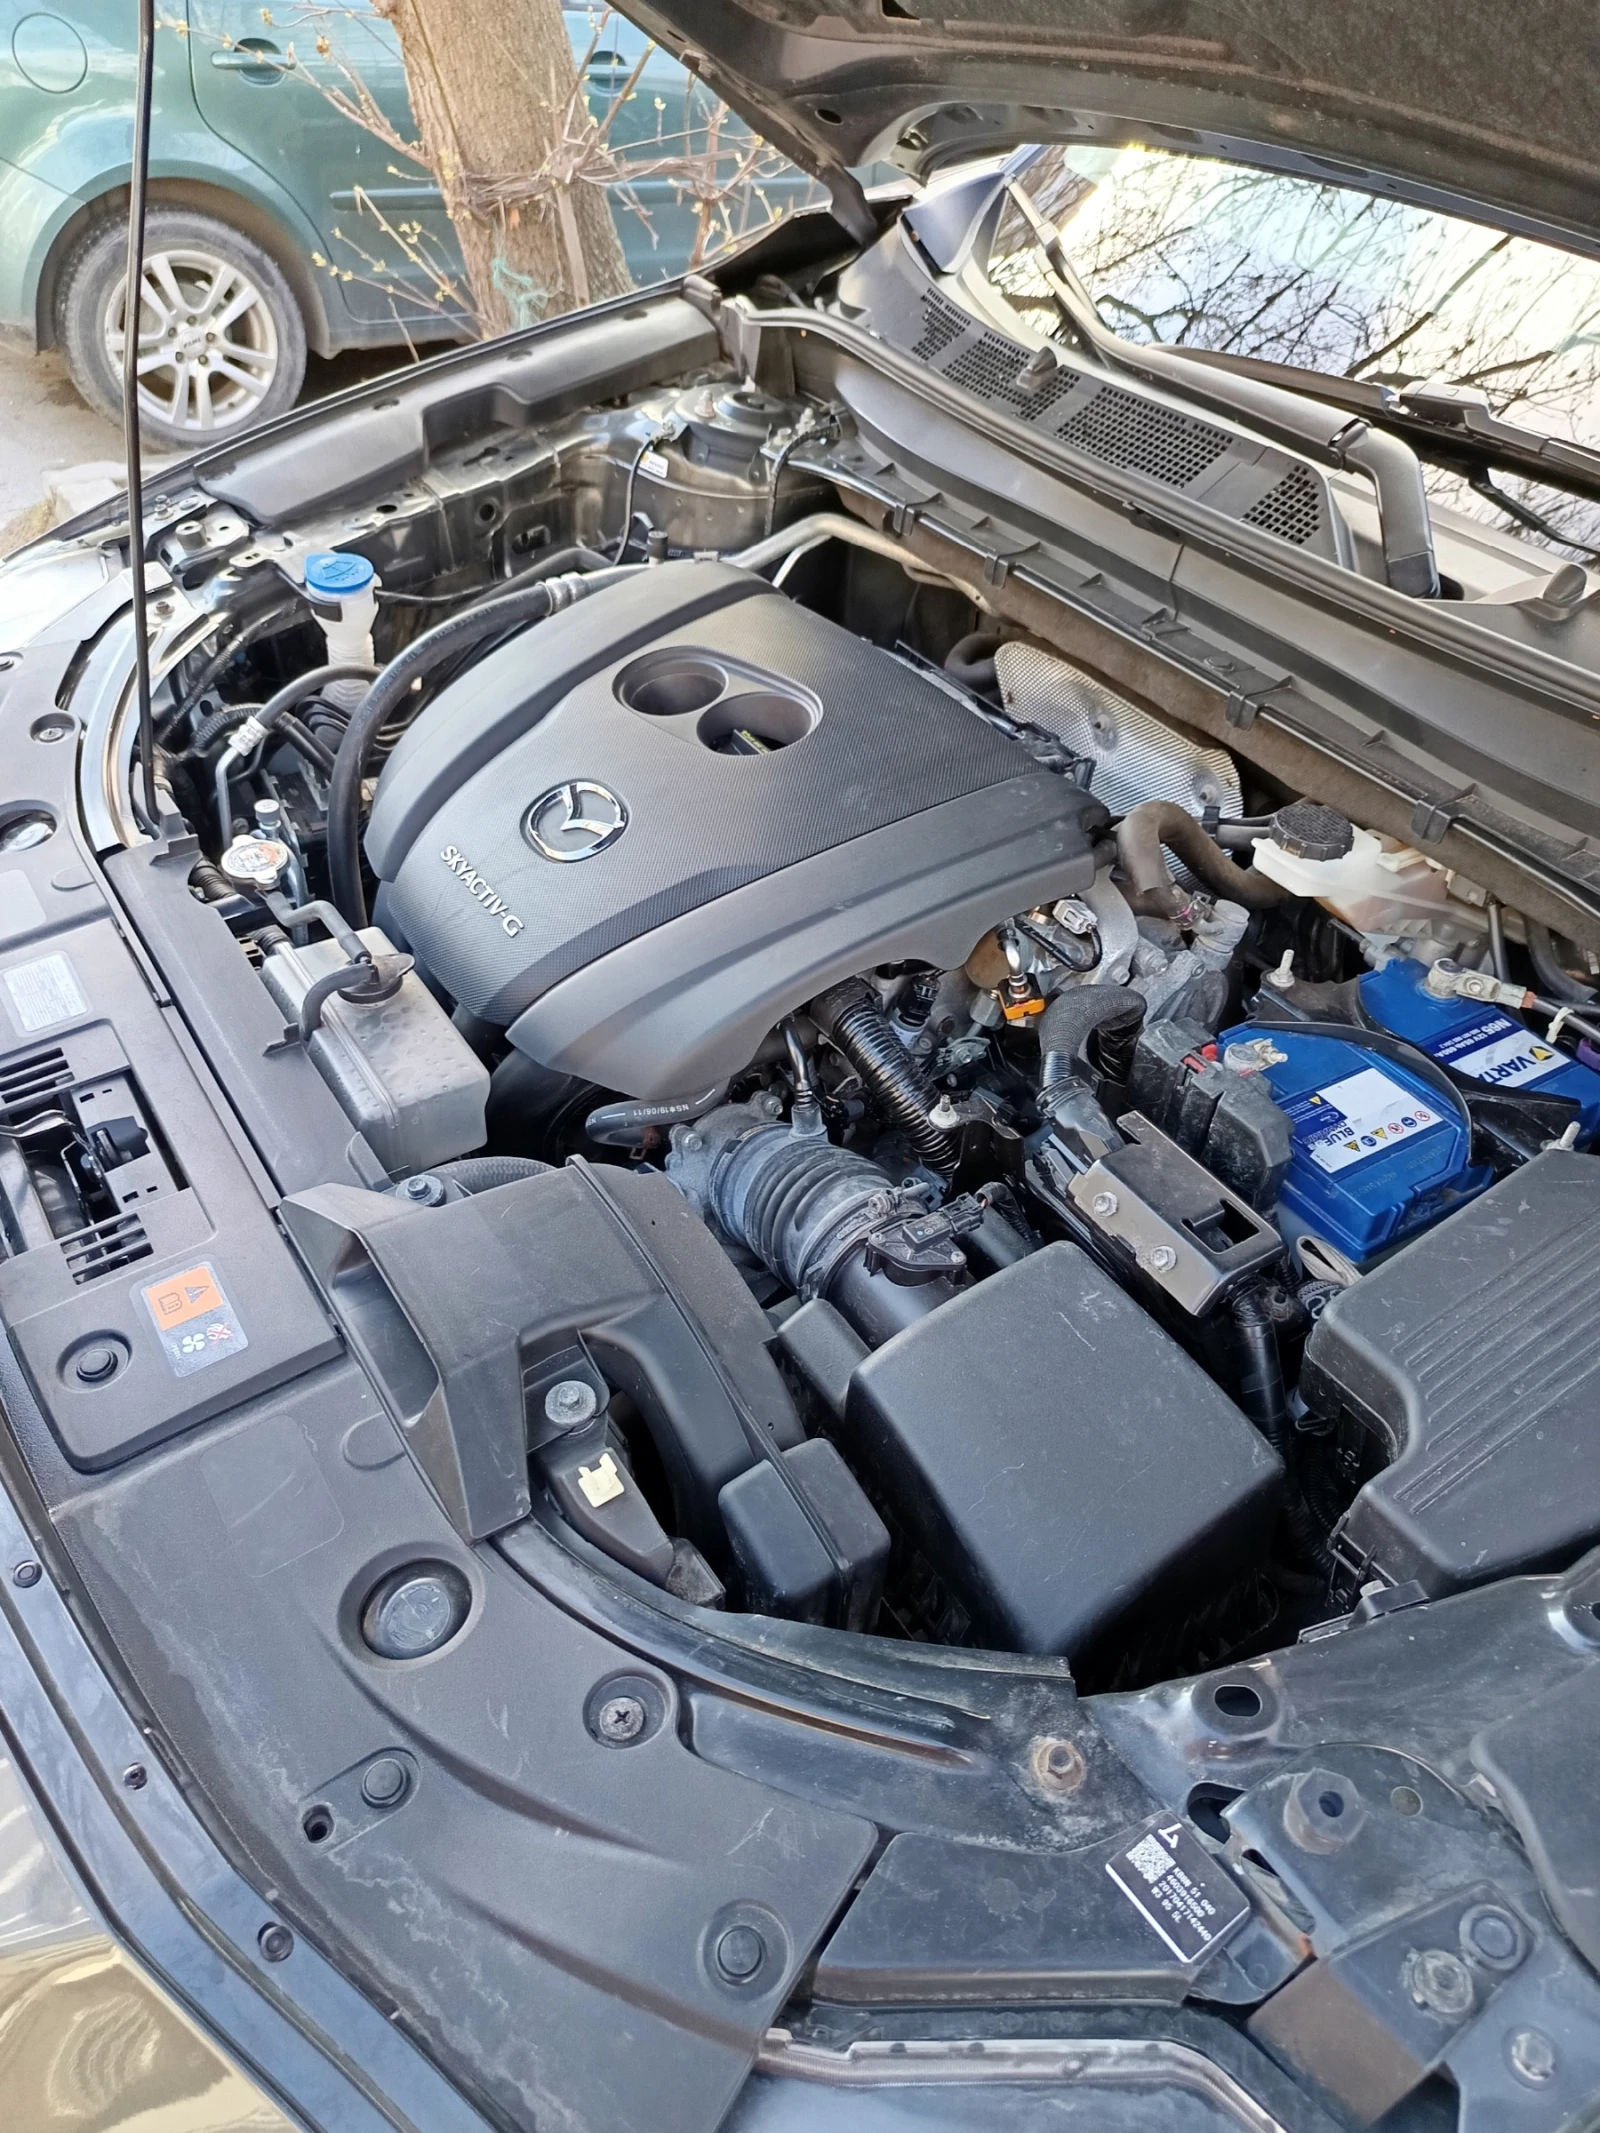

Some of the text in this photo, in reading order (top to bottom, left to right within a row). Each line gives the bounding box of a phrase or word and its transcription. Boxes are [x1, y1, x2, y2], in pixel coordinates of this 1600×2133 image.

[440, 845, 525, 938] SKYACTIV-G
[1481, 1018, 1512, 1036] N65
[1324, 1127, 1355, 1147] BLUE
[1200, 1899, 1217, 1915] 040
